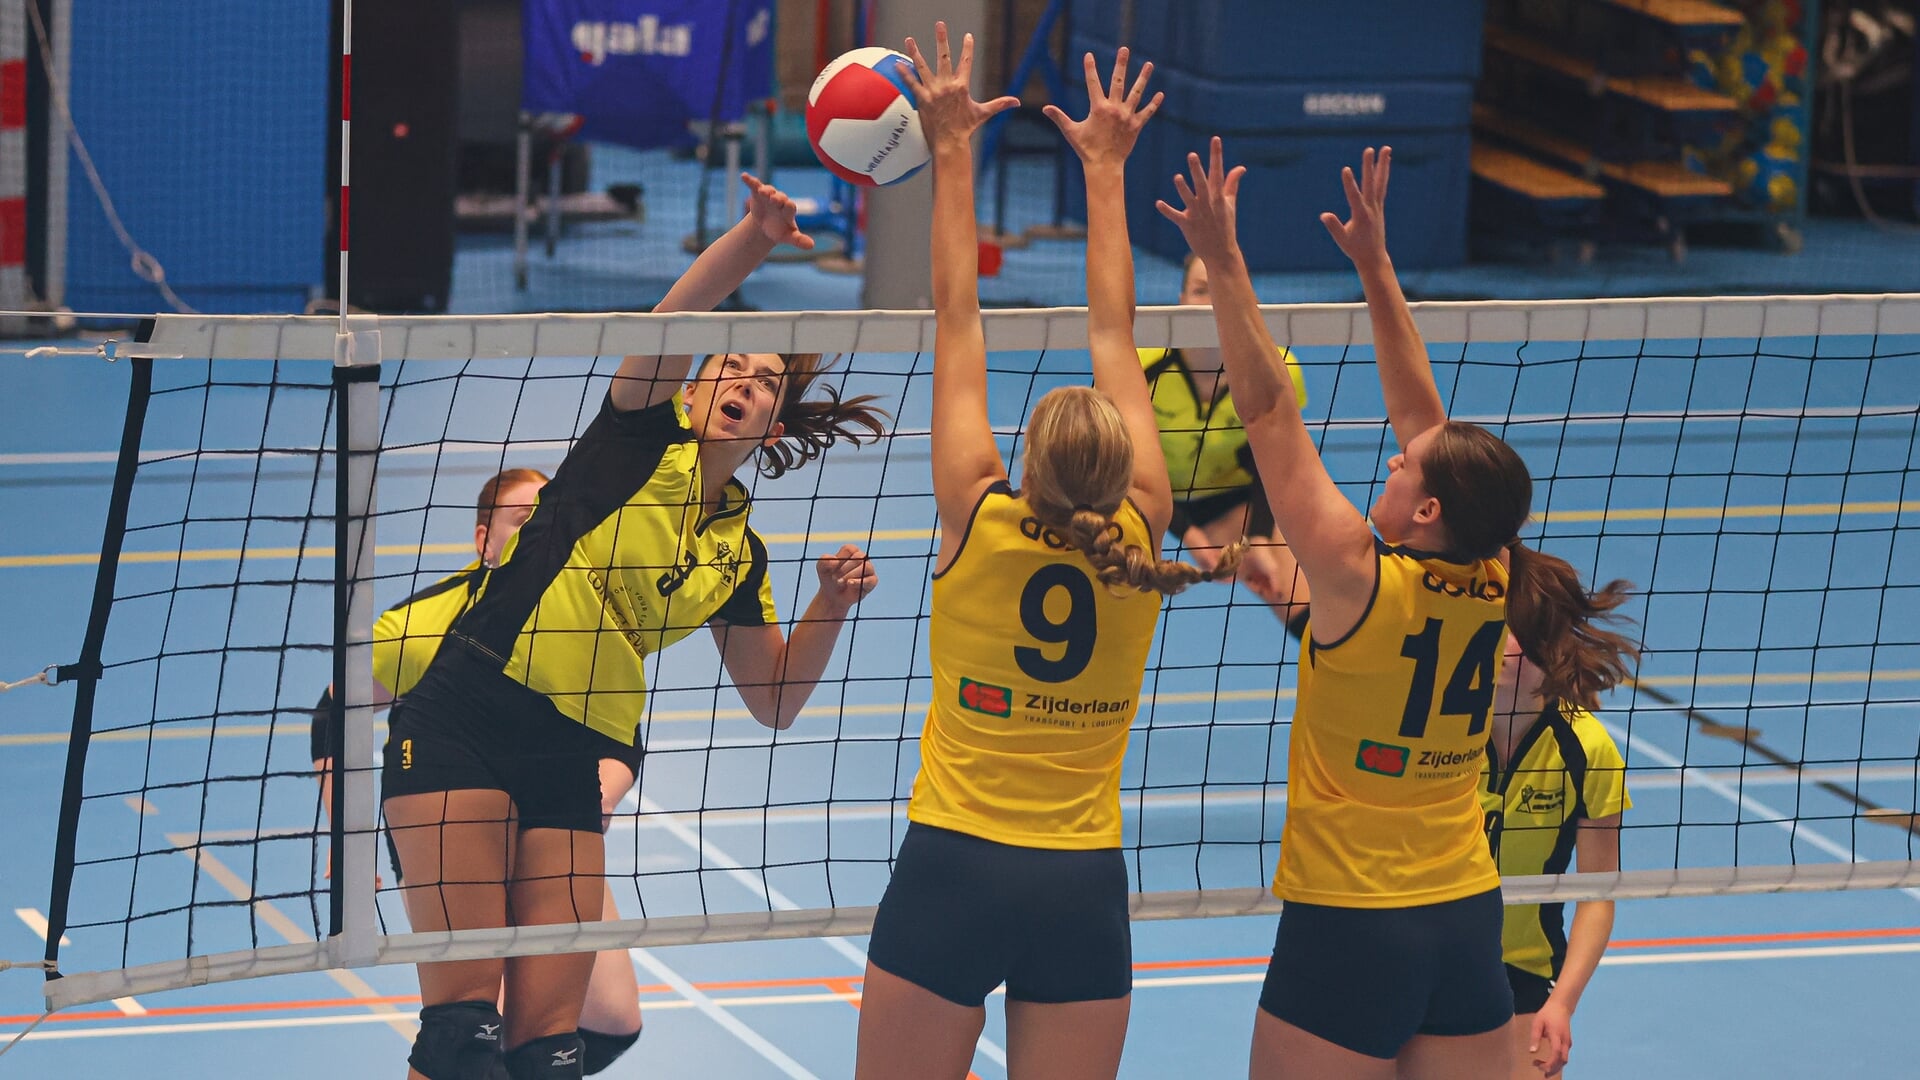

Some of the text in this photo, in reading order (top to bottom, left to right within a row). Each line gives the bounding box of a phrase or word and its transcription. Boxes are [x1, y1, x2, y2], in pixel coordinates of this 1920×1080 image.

[571, 14, 691, 66] gala
[1014, 563, 1098, 683] 9
[1025, 693, 1130, 714] Zijderlaan
[1398, 617, 1505, 738] 14
[401, 739, 412, 770] 3
